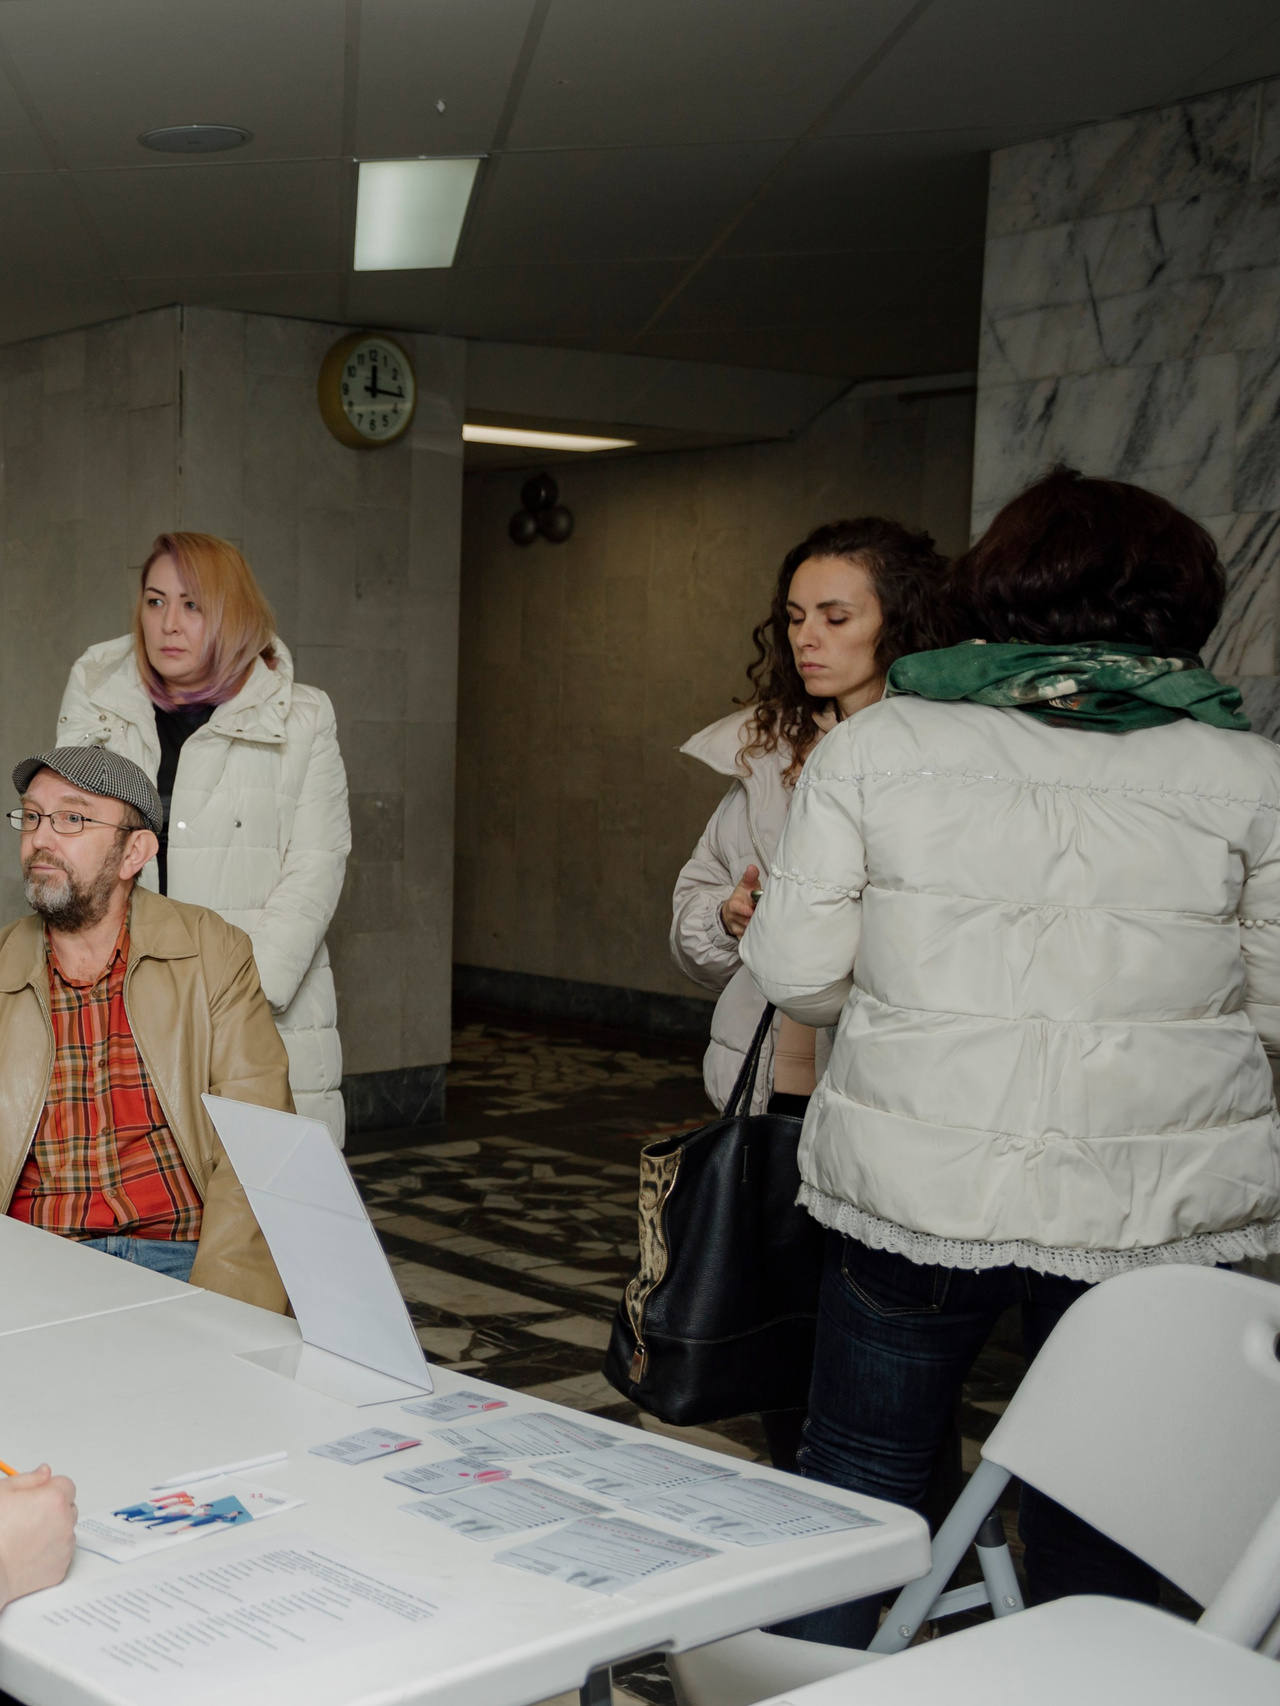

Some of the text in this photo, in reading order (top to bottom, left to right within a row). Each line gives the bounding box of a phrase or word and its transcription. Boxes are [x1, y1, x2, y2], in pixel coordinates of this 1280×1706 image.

[358, 353, 365, 366] 11
[369, 349, 378, 362] 12
[347, 365, 356, 378] 10
[392, 368, 398, 381] 2
[342, 382, 349, 396] 9
[391, 403, 398, 414] 4
[357, 413, 363, 426] 7
[369, 419, 376, 431] 6
[382, 414, 388, 427] 5
